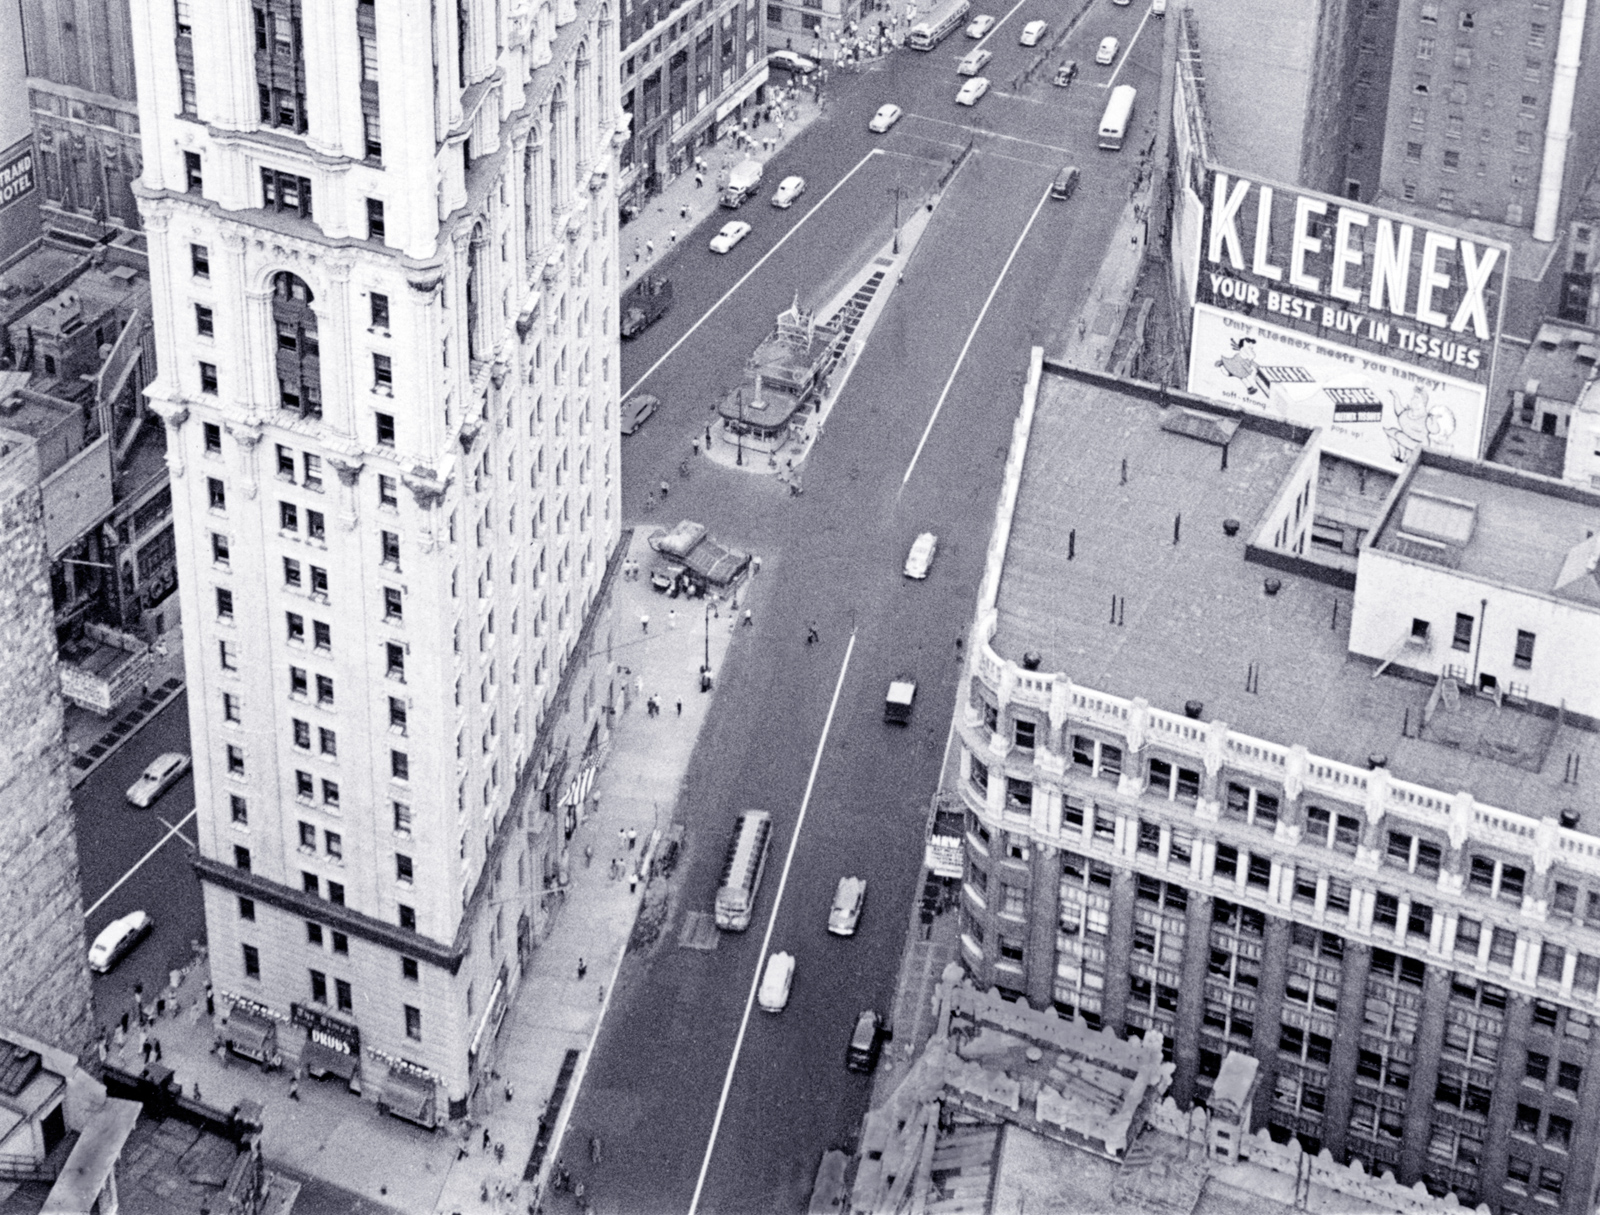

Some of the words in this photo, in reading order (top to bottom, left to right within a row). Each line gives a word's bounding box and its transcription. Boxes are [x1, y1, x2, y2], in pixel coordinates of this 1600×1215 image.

[1208, 173, 1501, 340] KLEENEX
[1209, 273, 1260, 307] YOUR
[1267, 292, 1316, 322] BEST
[1322, 307, 1363, 335] BUY
[1368, 320, 1391, 344] IN
[1397, 328, 1482, 370] TISSUES
[1223, 316, 1253, 335] Only
[1315, 344, 1356, 364] meets
[1362, 359, 1387, 374] you
[1261, 366, 1314, 382] KLEENEX
[1222, 390, 1237, 399] soft
[1242, 396, 1267, 410] strong
[1324, 389, 1379, 404] TISSUES
